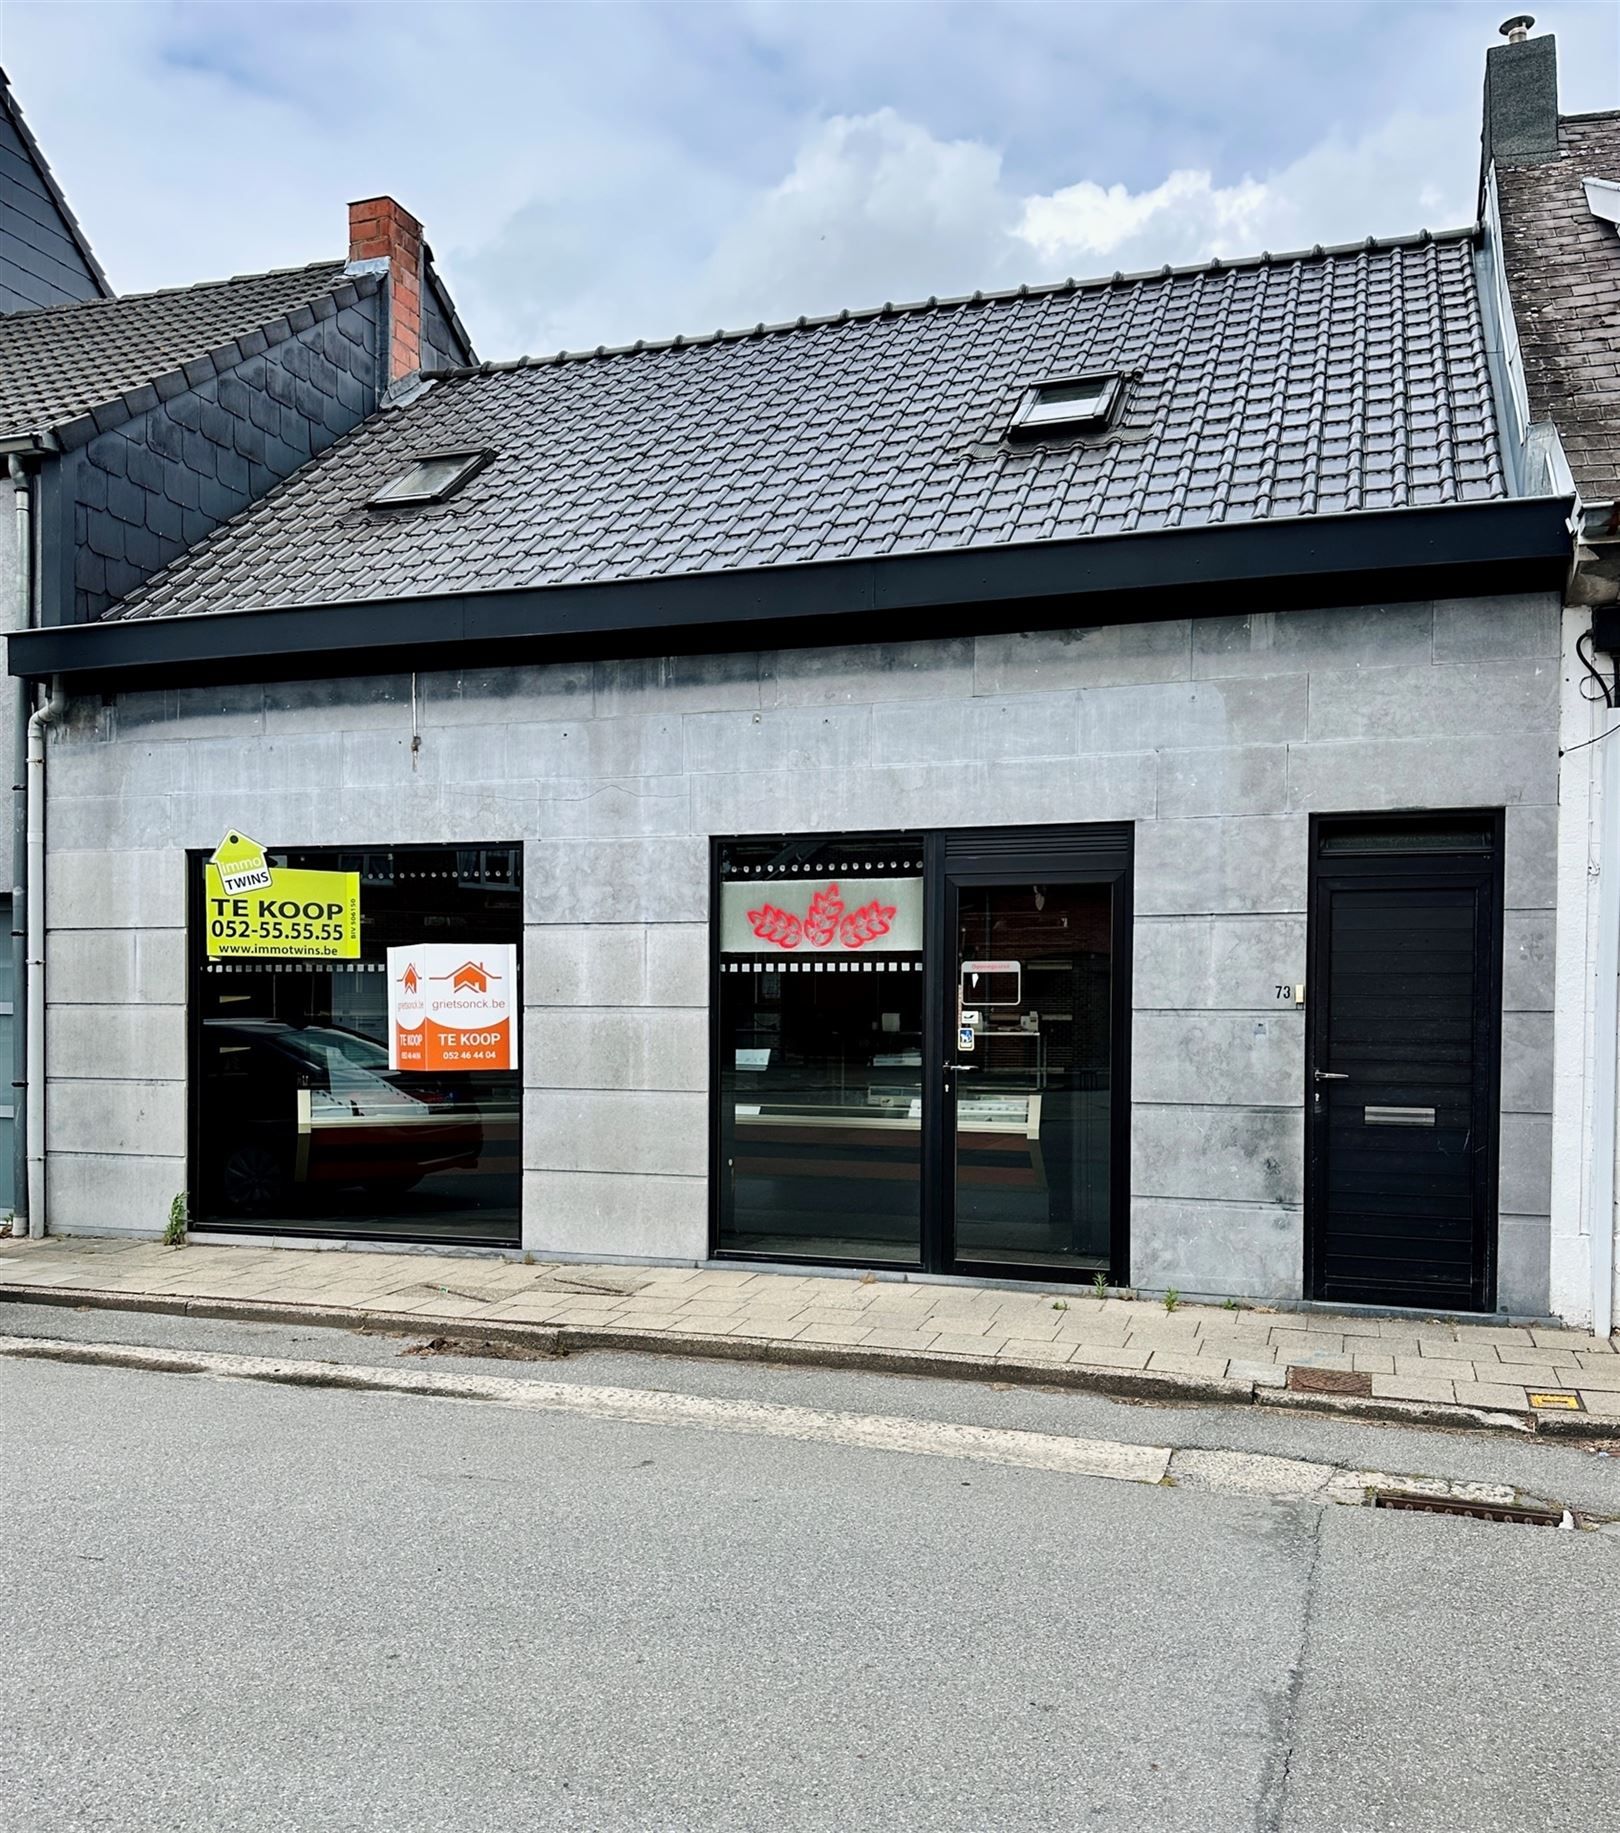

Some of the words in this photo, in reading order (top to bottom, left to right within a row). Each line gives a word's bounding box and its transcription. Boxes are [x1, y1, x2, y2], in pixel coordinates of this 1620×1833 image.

[222, 857, 262, 873] immo
[225, 871, 269, 890] TWINS
[211, 898, 249, 917] TE
[259, 900, 344, 920] KOOP
[211, 919, 344, 941] 052-55.55.55
[219, 943, 338, 956] www.immotwins.be
[1275, 985, 1291, 999] 73
[432, 1000, 506, 1011] grietsonck.be
[438, 1033, 457, 1046] TE
[460, 1033, 501, 1046] KOOP
[443, 1051, 459, 1060] 052
[461, 1051, 472, 1060] 46
[474, 1051, 484, 1060] 44
[485, 1051, 496, 1059] 04
